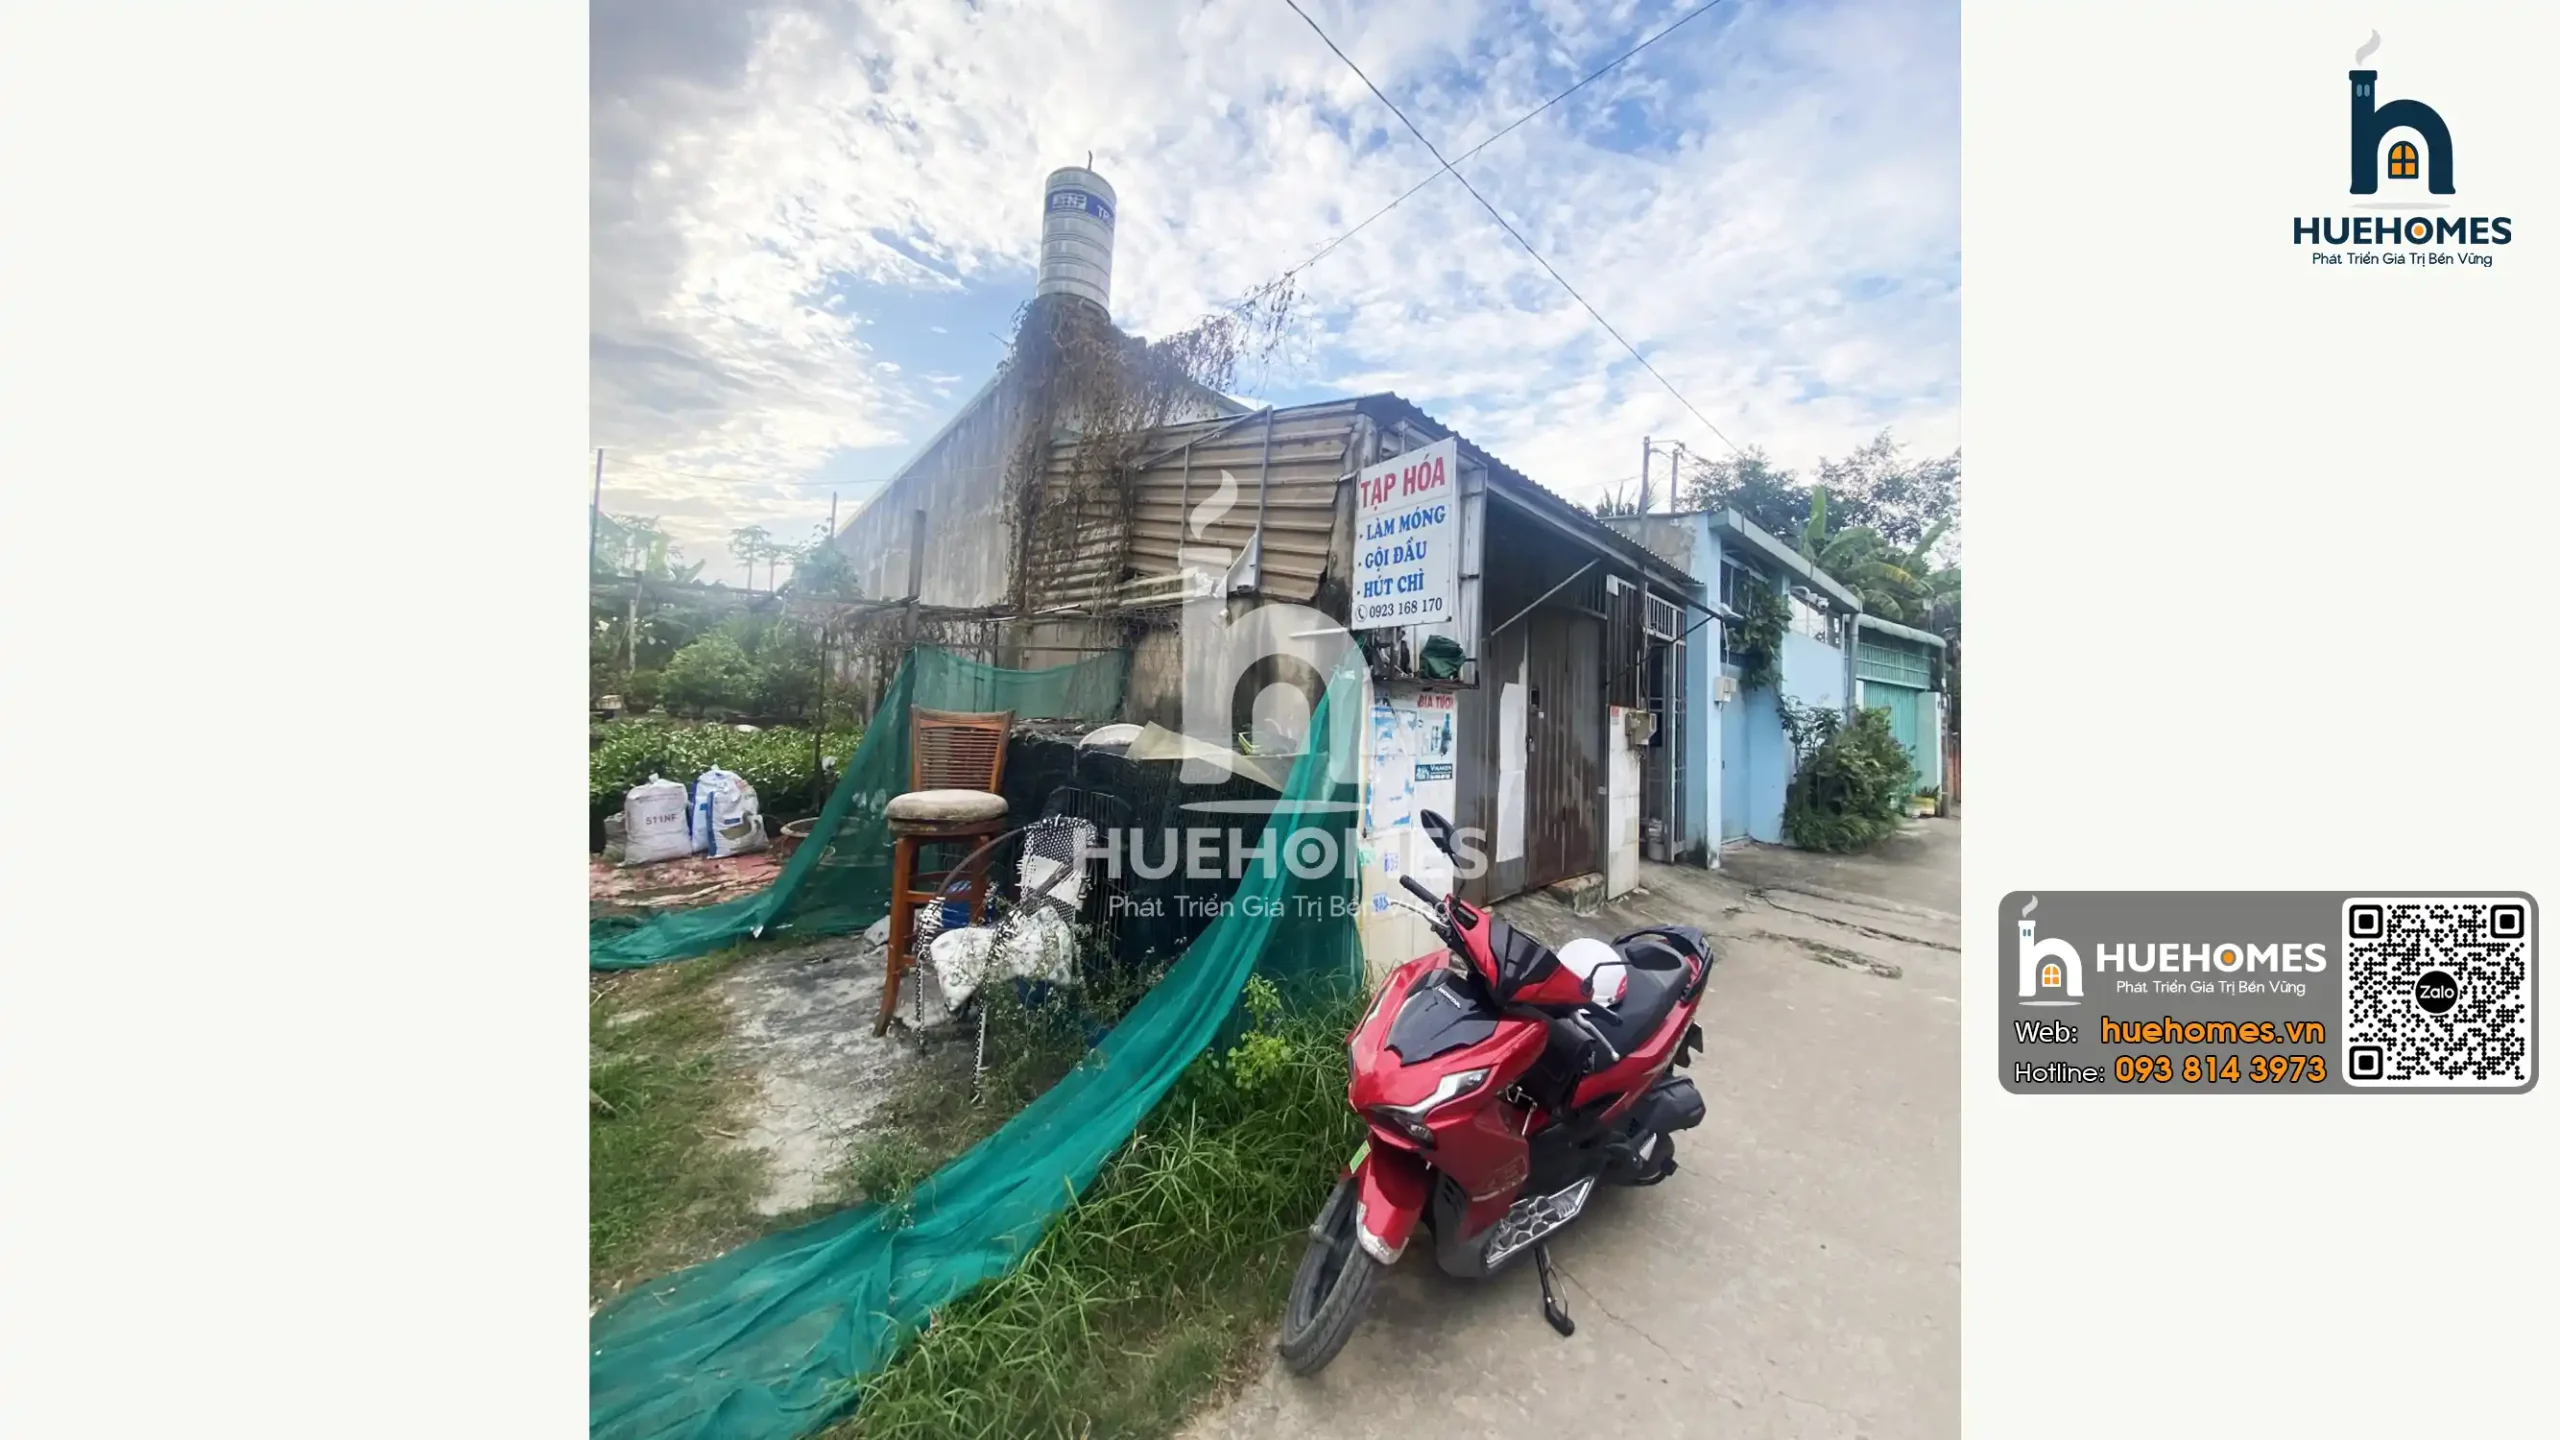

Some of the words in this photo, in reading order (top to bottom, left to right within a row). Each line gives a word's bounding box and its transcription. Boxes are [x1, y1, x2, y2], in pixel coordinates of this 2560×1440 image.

[1360, 473, 1396, 511] TẠP
[1403, 453, 1445, 497] HÓA
[1366, 518, 1395, 541] LÀM
[1399, 505, 1446, 535] MÓNG
[1365, 546, 1389, 572] GỘI
[1393, 536, 1427, 564] ĐẦU
[1363, 574, 1394, 598] HÚT
[1369, 603, 1394, 618] 0923
[1398, 600, 1418, 616] 168
[1422, 597, 1443, 613] 170
